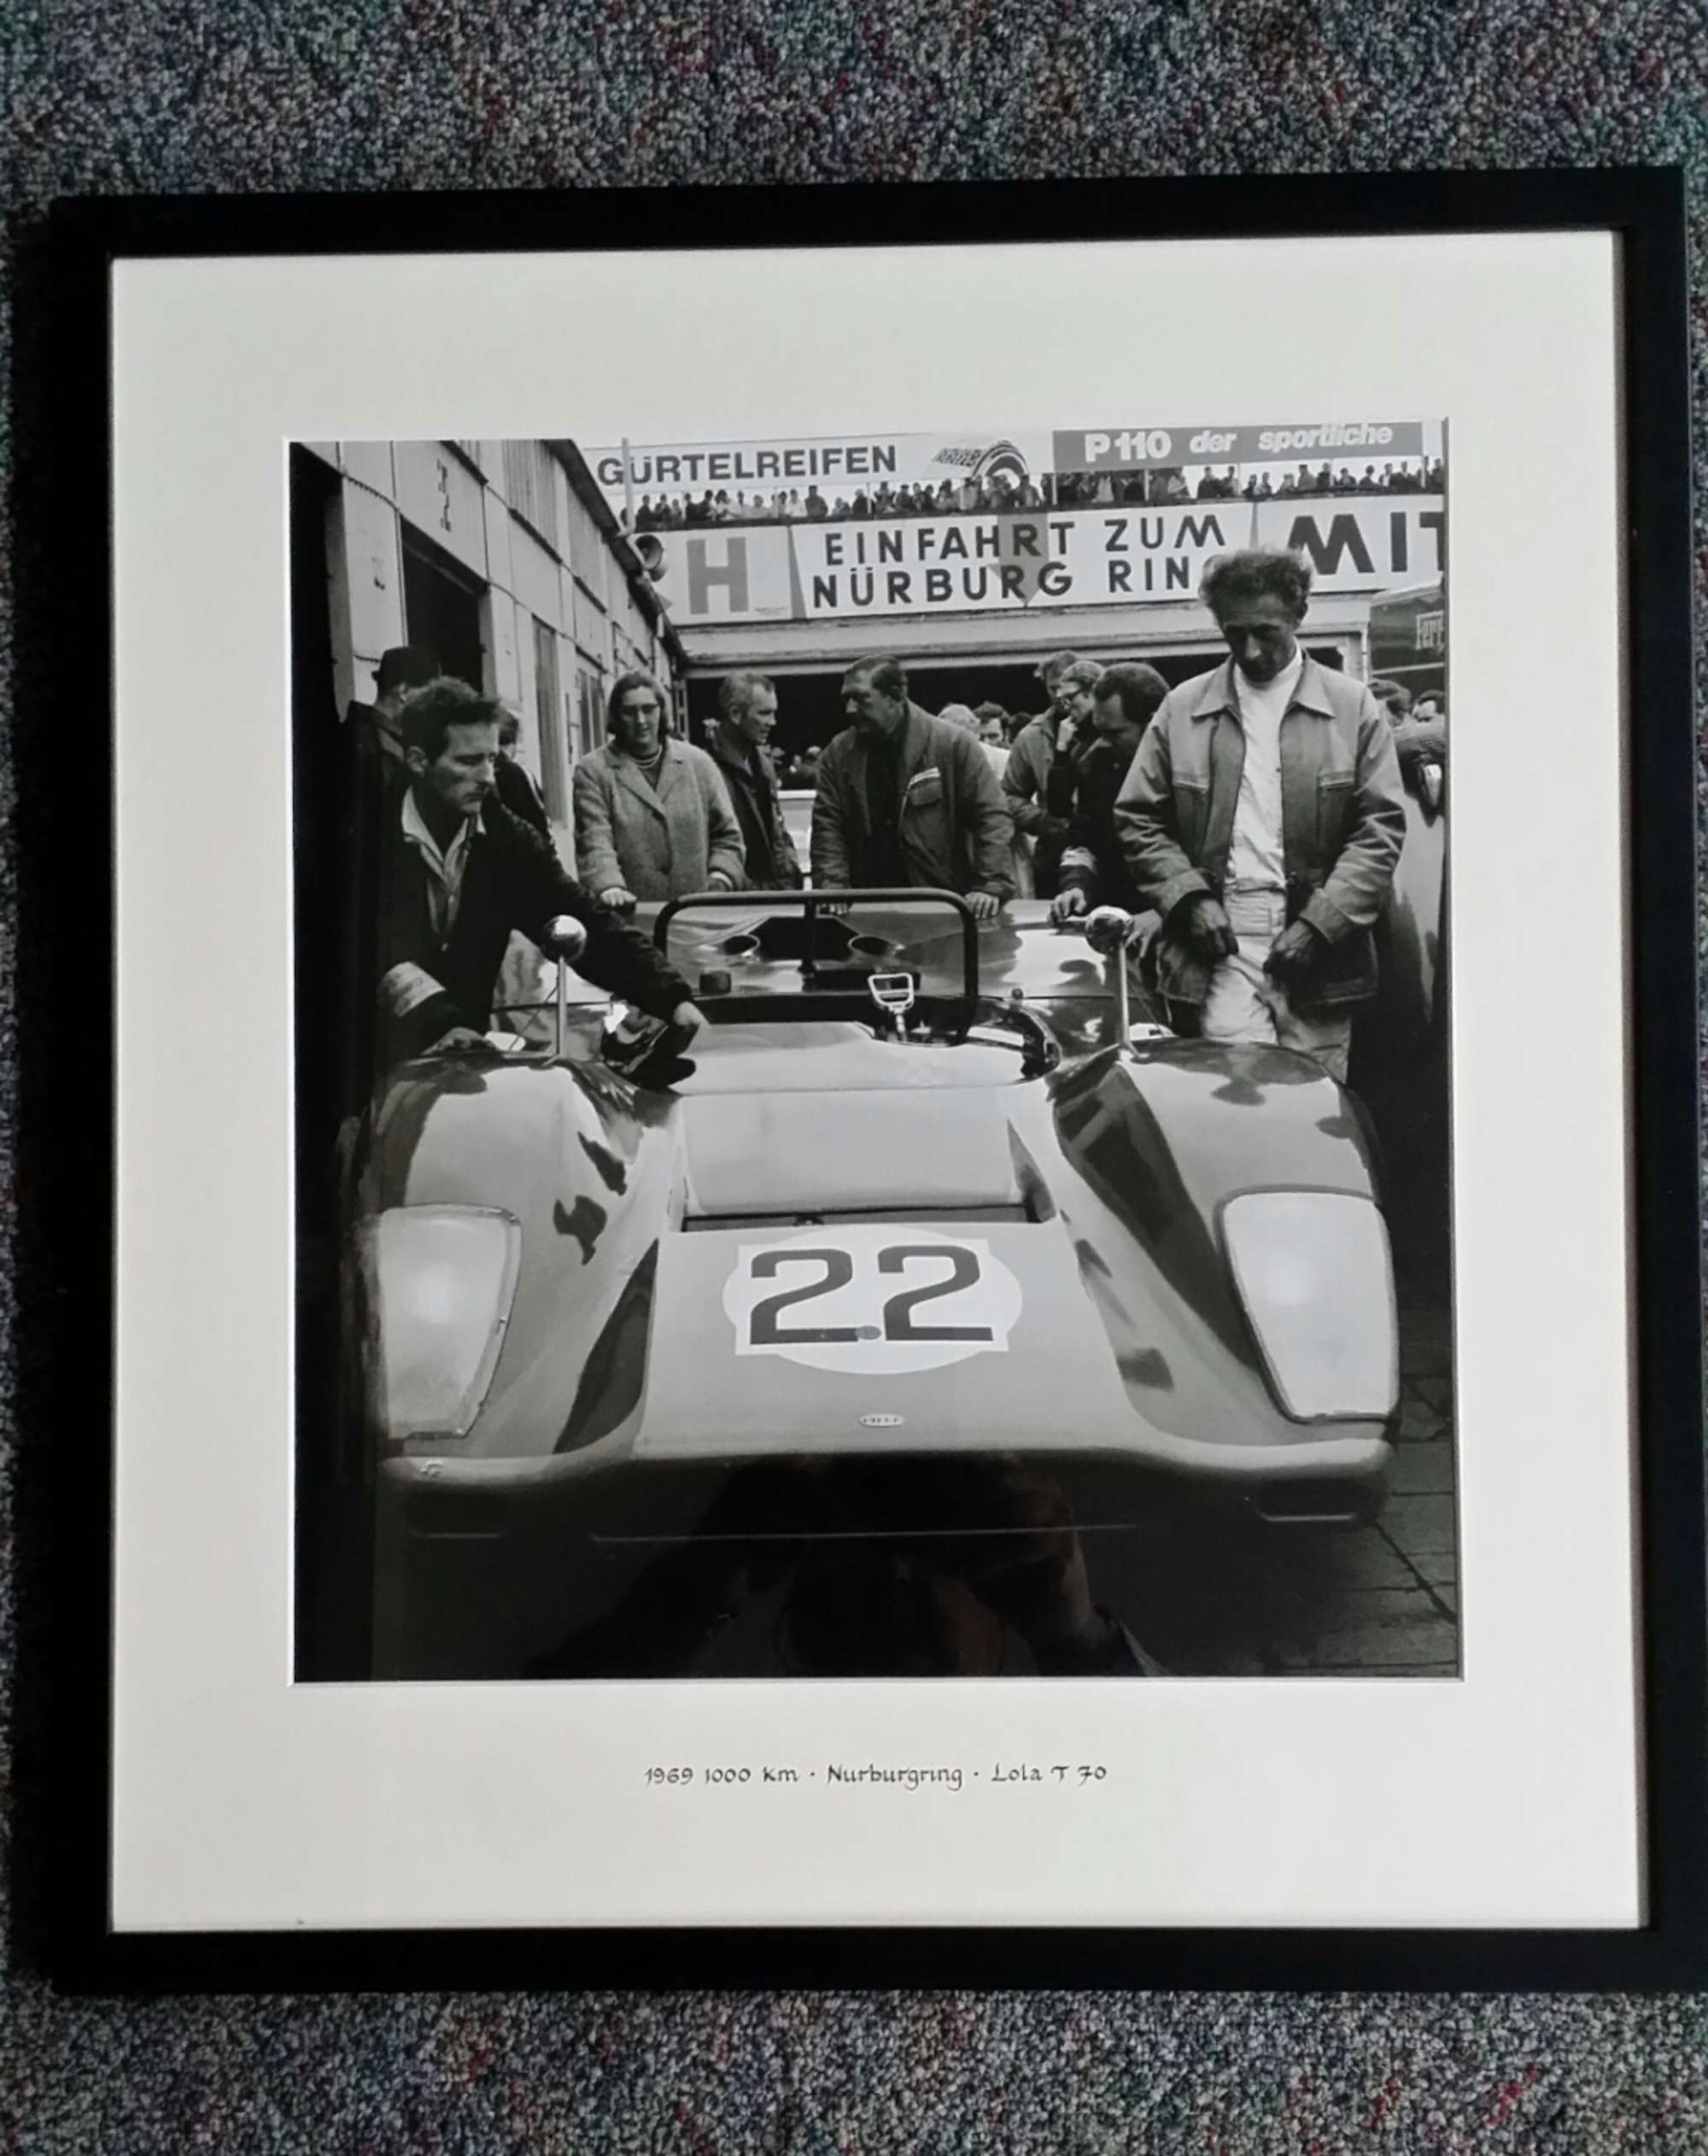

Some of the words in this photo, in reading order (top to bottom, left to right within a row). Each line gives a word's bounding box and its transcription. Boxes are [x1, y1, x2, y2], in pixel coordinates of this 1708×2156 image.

[1189, 432, 1237, 453] der
[1258, 424, 1393, 451] sportliche
[598, 445, 897, 485] GÜRTELREIFEN
[825, 521, 1076, 566] EINFAHRT
[1104, 514, 1226, 552] ZUM
[686, 536, 749, 615] H
[812, 561, 1073, 609] NÜRBURG
[1108, 556, 1190, 593] RIN
[750, 1244, 994, 1345] 22
[644, 1767, 693, 1785] 1969
[705, 1767, 752, 1785] 1000
[828, 1763, 963, 1791] Nurburgring
[991, 1763, 1043, 1783] Lola
[1050, 1766, 1071, 1783] T
[1077, 1765, 1108, 1787] 70
